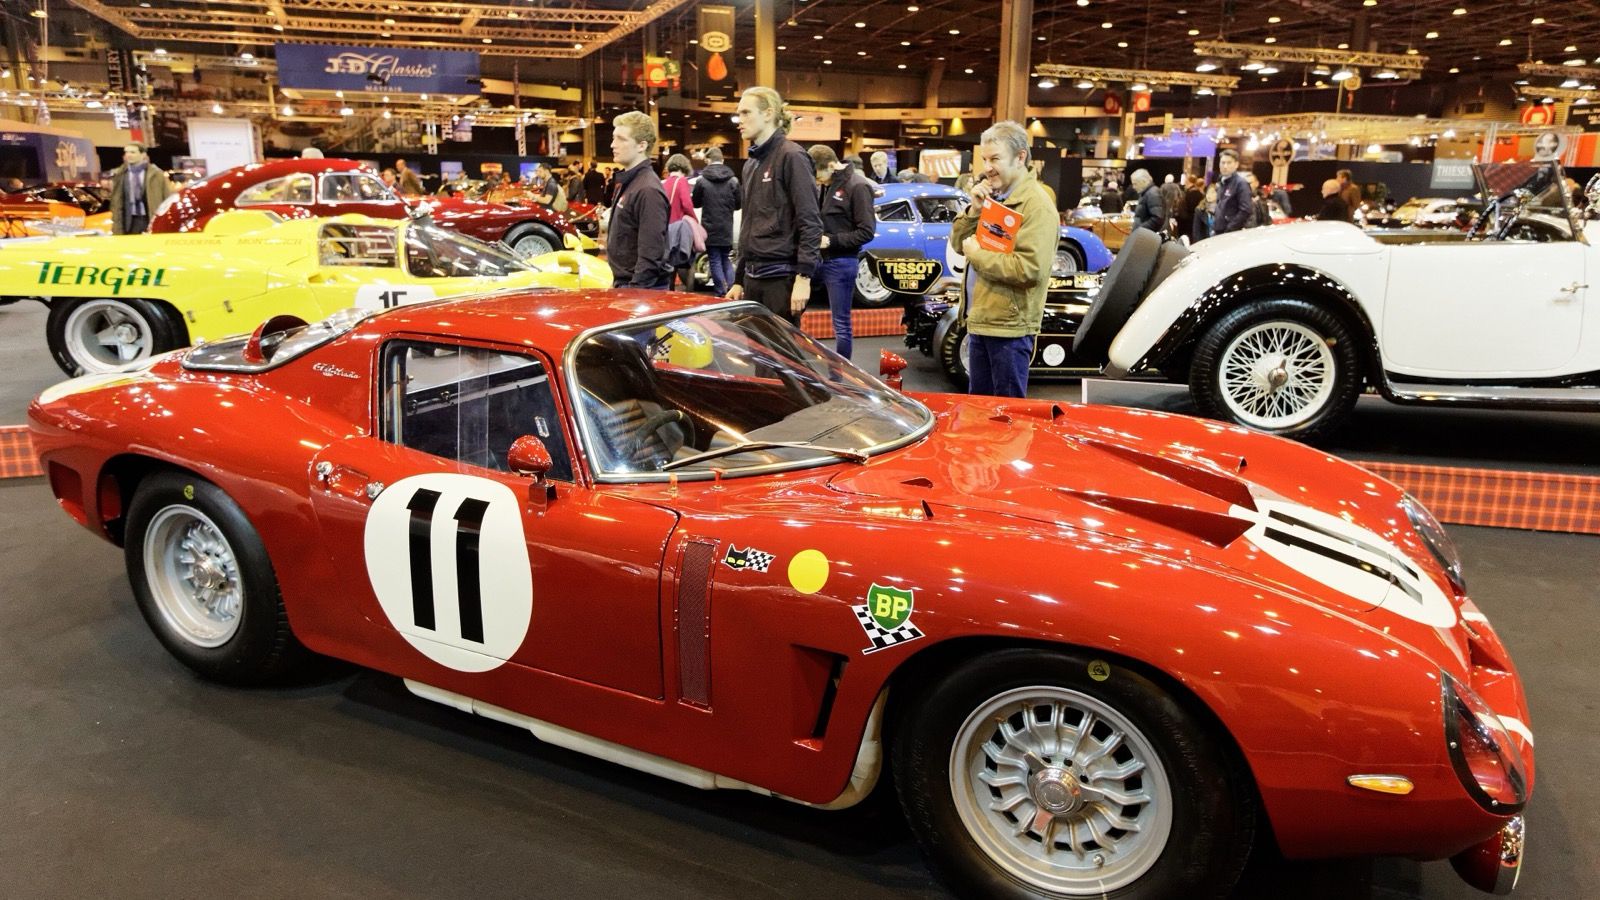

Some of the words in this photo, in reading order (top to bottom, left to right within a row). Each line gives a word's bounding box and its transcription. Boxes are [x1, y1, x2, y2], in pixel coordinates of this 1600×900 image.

[107, 49, 124, 91] ALLERY
[36, 261, 170, 295] TERGAL
[884, 262, 936, 274] TISSOT
[406, 487, 491, 645] 11
[1264, 509, 1424, 606] 11
[874, 593, 909, 620] BP
